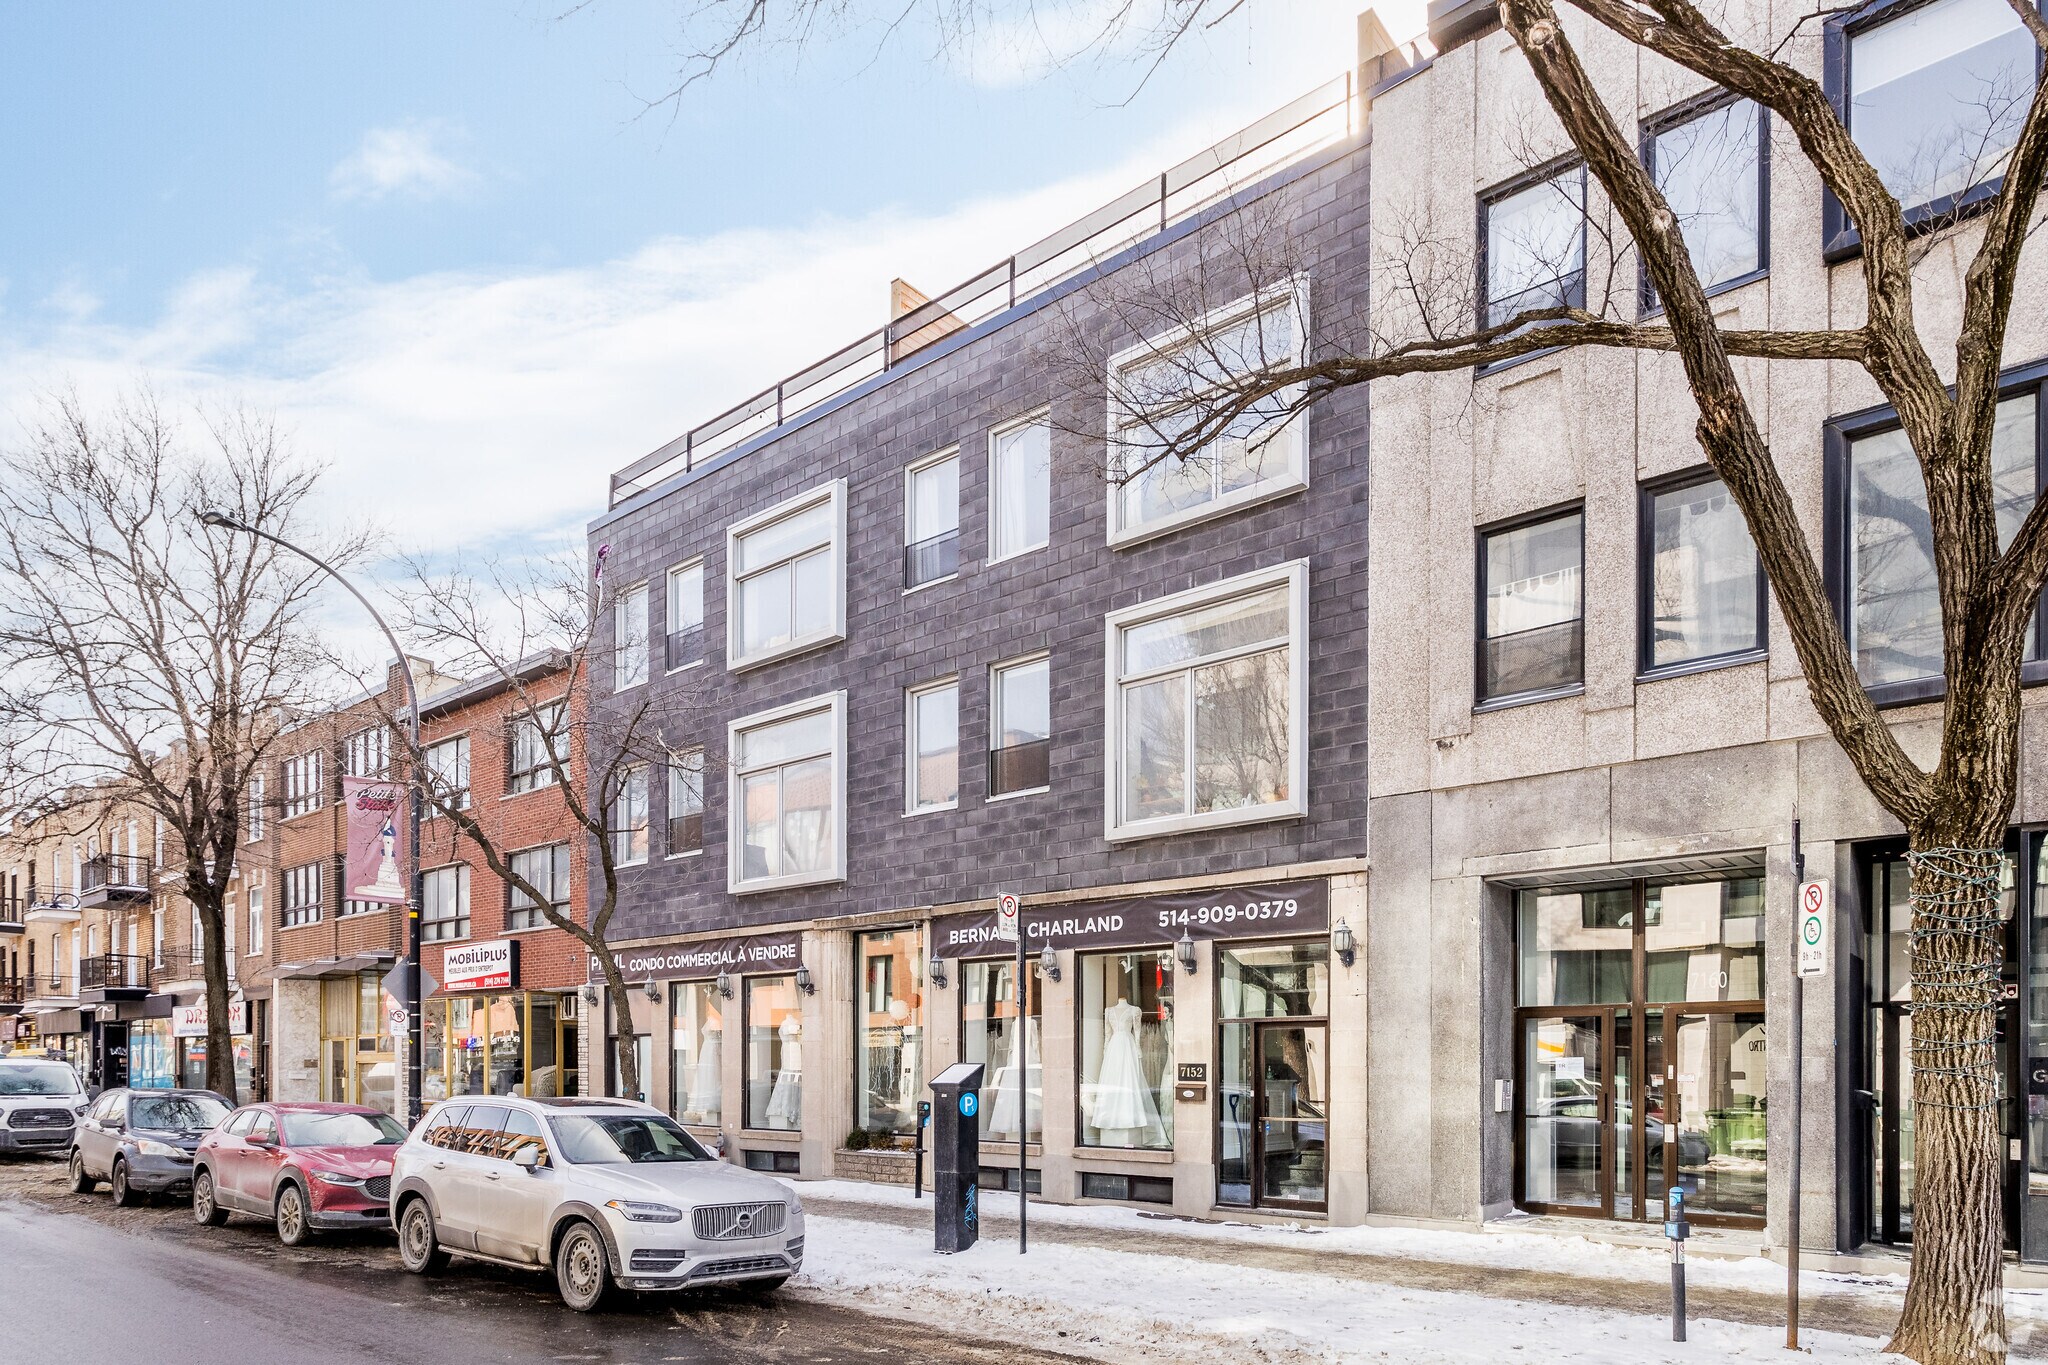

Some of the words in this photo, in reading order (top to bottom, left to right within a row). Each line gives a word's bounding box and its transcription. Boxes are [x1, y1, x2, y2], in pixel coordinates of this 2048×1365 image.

[949, 927, 1000, 945] BERNA
[1028, 915, 1123, 938] CHARLAND
[1158, 900, 1297, 927] 514-909-0379
[630, 957, 665, 972] CONDO
[666, 950, 735, 969] COMMERCIAL
[735, 945, 746, 963] À
[748, 944, 796, 961] VENDRE
[1691, 971, 1728, 988] 7160
[1180, 1066, 1203, 1078] 7152
